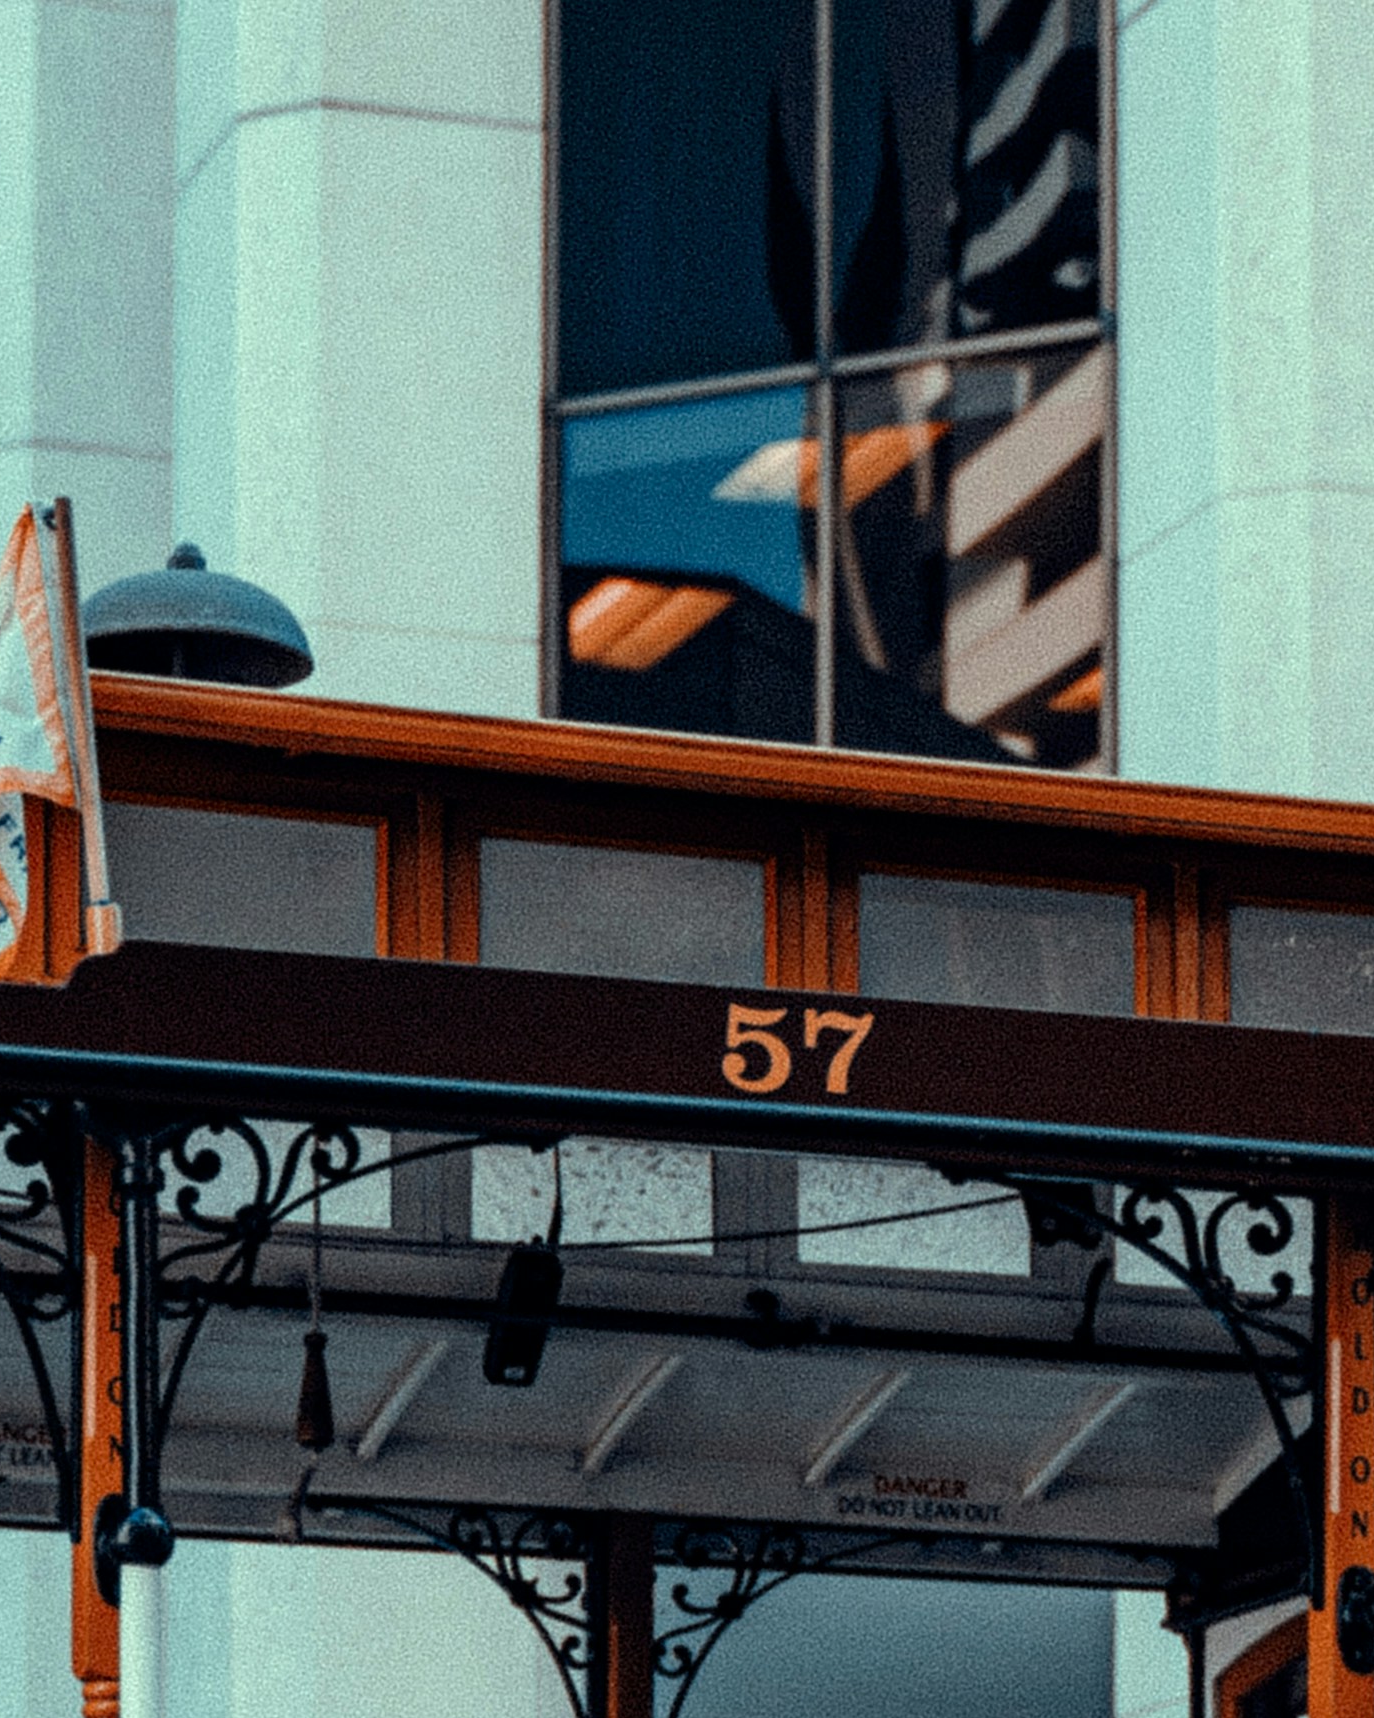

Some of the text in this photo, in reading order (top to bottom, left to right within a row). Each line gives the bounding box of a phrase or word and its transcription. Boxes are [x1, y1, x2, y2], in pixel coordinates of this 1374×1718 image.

[721, 1002, 875, 1095] 57
[1350, 1276, 1372, 1539] OLD ON
[10, 1447, 55, 1468] LEA
[874, 1474, 969, 1498] DANGER
[838, 1494, 1002, 1523] DO NOT LEAN OUT
